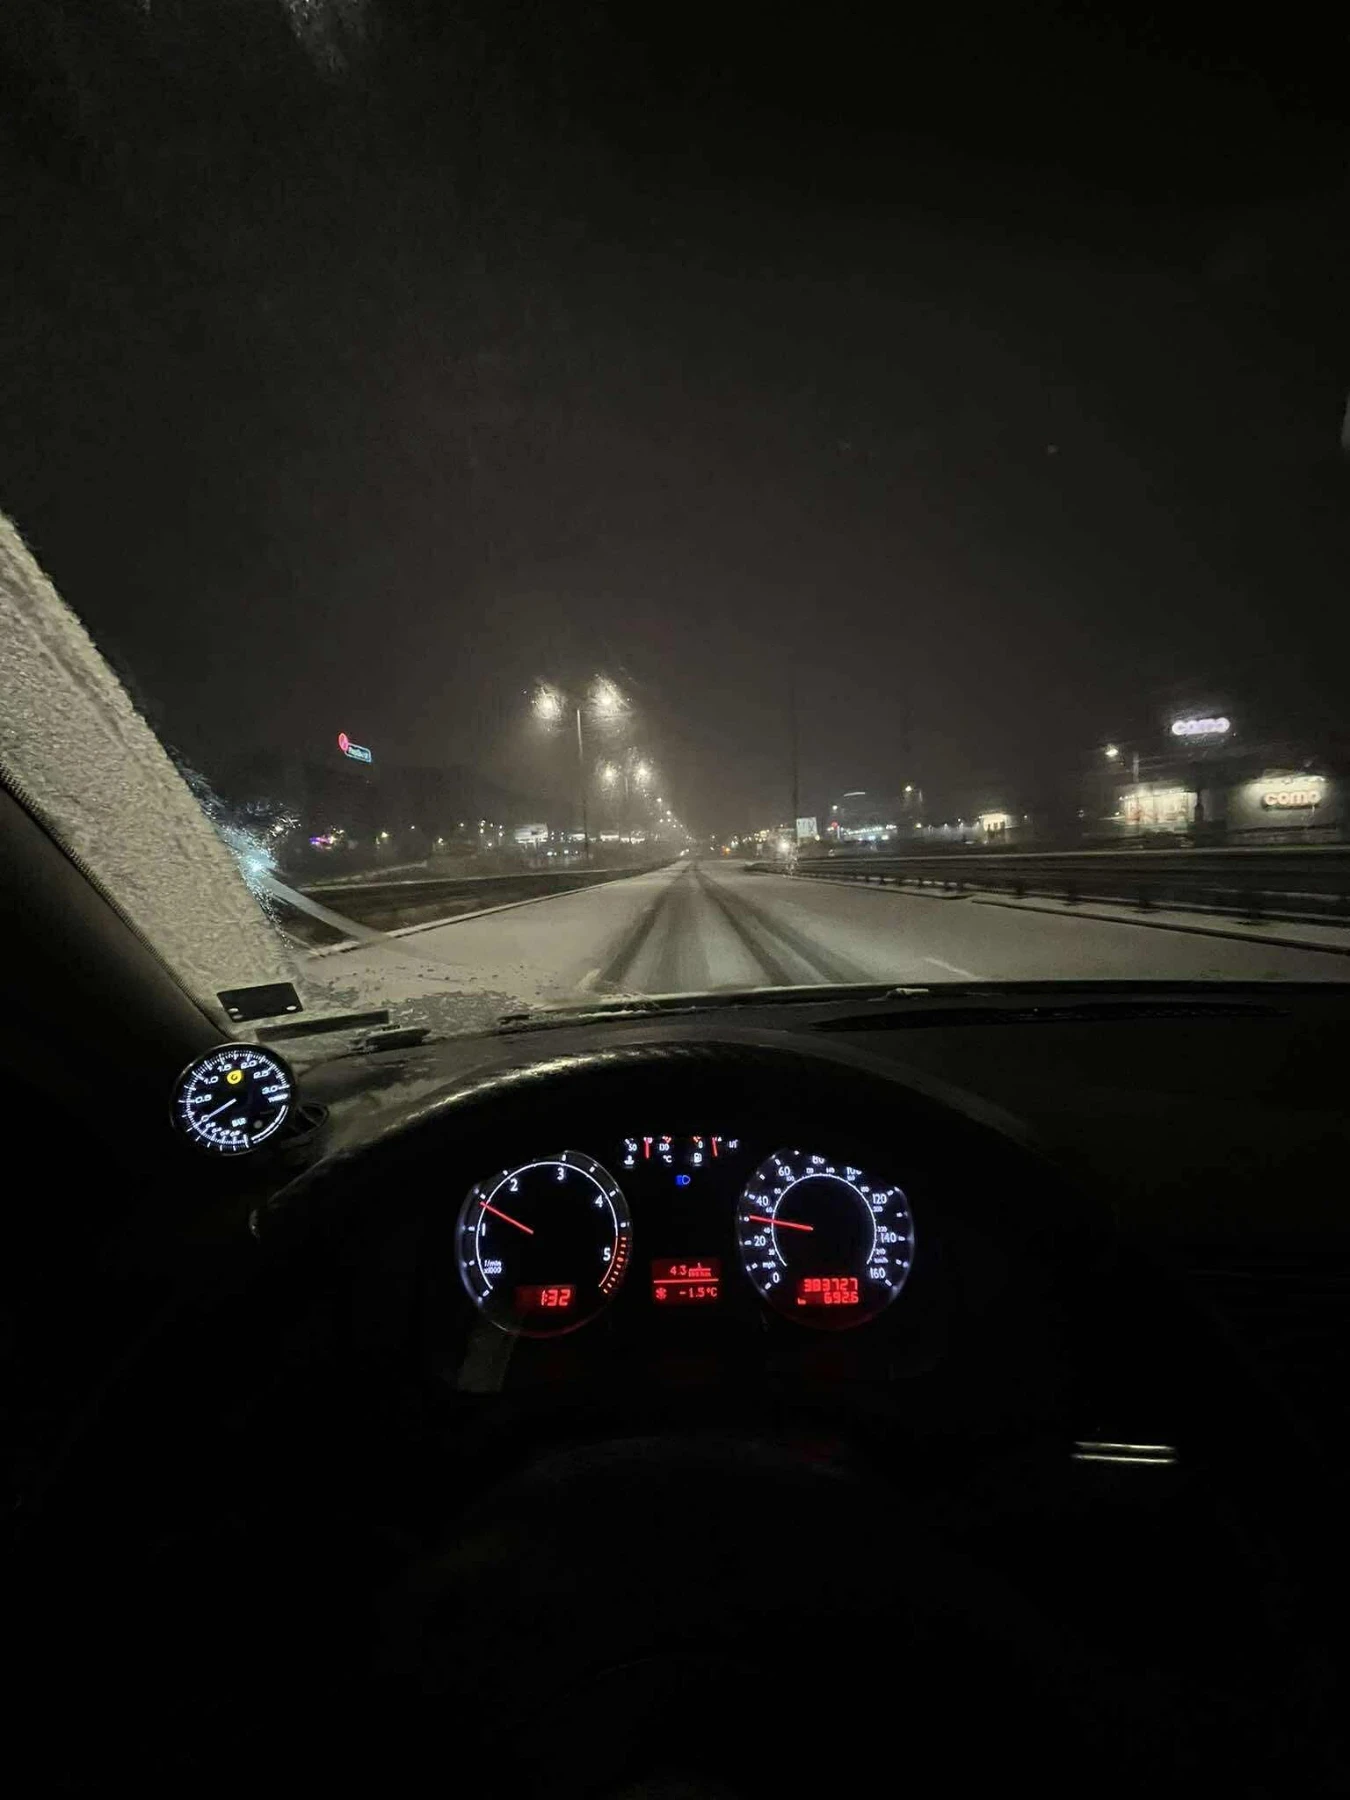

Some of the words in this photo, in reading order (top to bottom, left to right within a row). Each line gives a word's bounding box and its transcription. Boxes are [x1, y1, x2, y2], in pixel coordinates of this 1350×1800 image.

[1263, 790, 1321, 806] como
[557, 1168, 565, 1181] 3
[778, 1165, 791, 1177] 60
[510, 1179, 519, 1192] 2
[595, 1195, 604, 1208] 4
[756, 1195, 769, 1207] 40
[872, 1193, 887, 1204] 120
[754, 1235, 766, 1247] 20
[880, 1231, 897, 1243] 140
[603, 1247, 611, 1261] 5
[773, 1272, 780, 1284] 0
[869, 1267, 886, 1279] 160
[541, 1289, 571, 1306] 1:32
